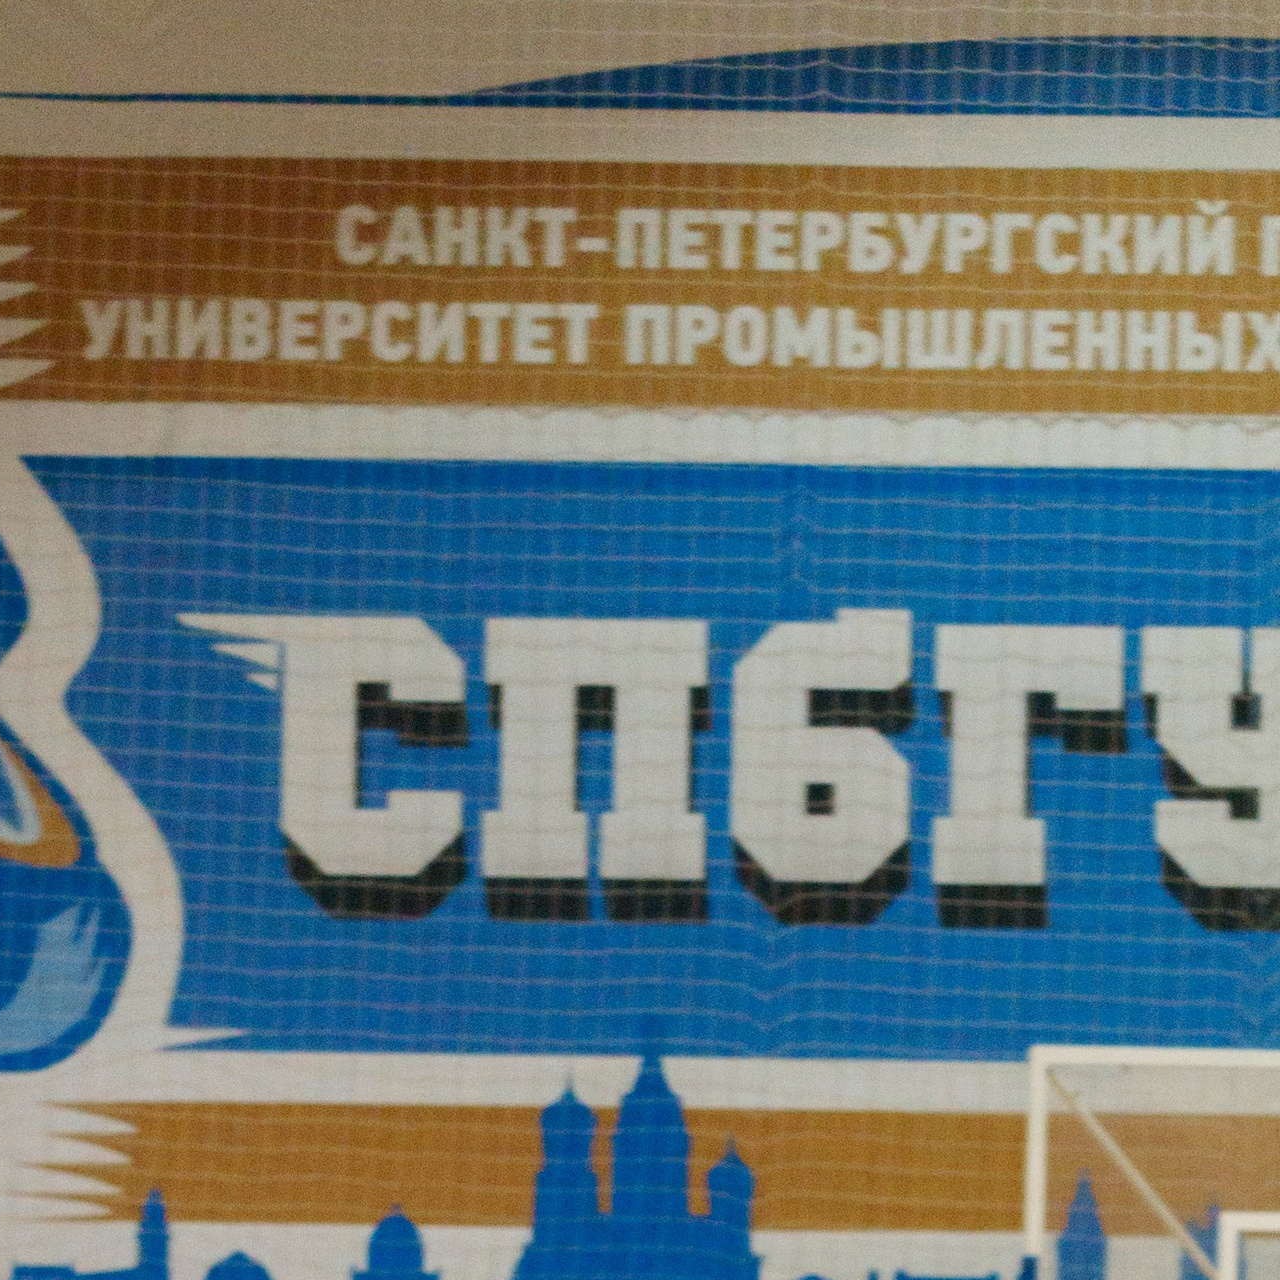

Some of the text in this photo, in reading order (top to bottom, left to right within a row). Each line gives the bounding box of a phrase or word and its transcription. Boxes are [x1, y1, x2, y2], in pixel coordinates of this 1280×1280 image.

[333, 199, 1236, 277] САНКТ-ПЕТЕРБУРГСКИЙ
[79, 299, 1280, 373] УНИВЕРСИТЕТ ПРОМЫШЛЕННЫХ
